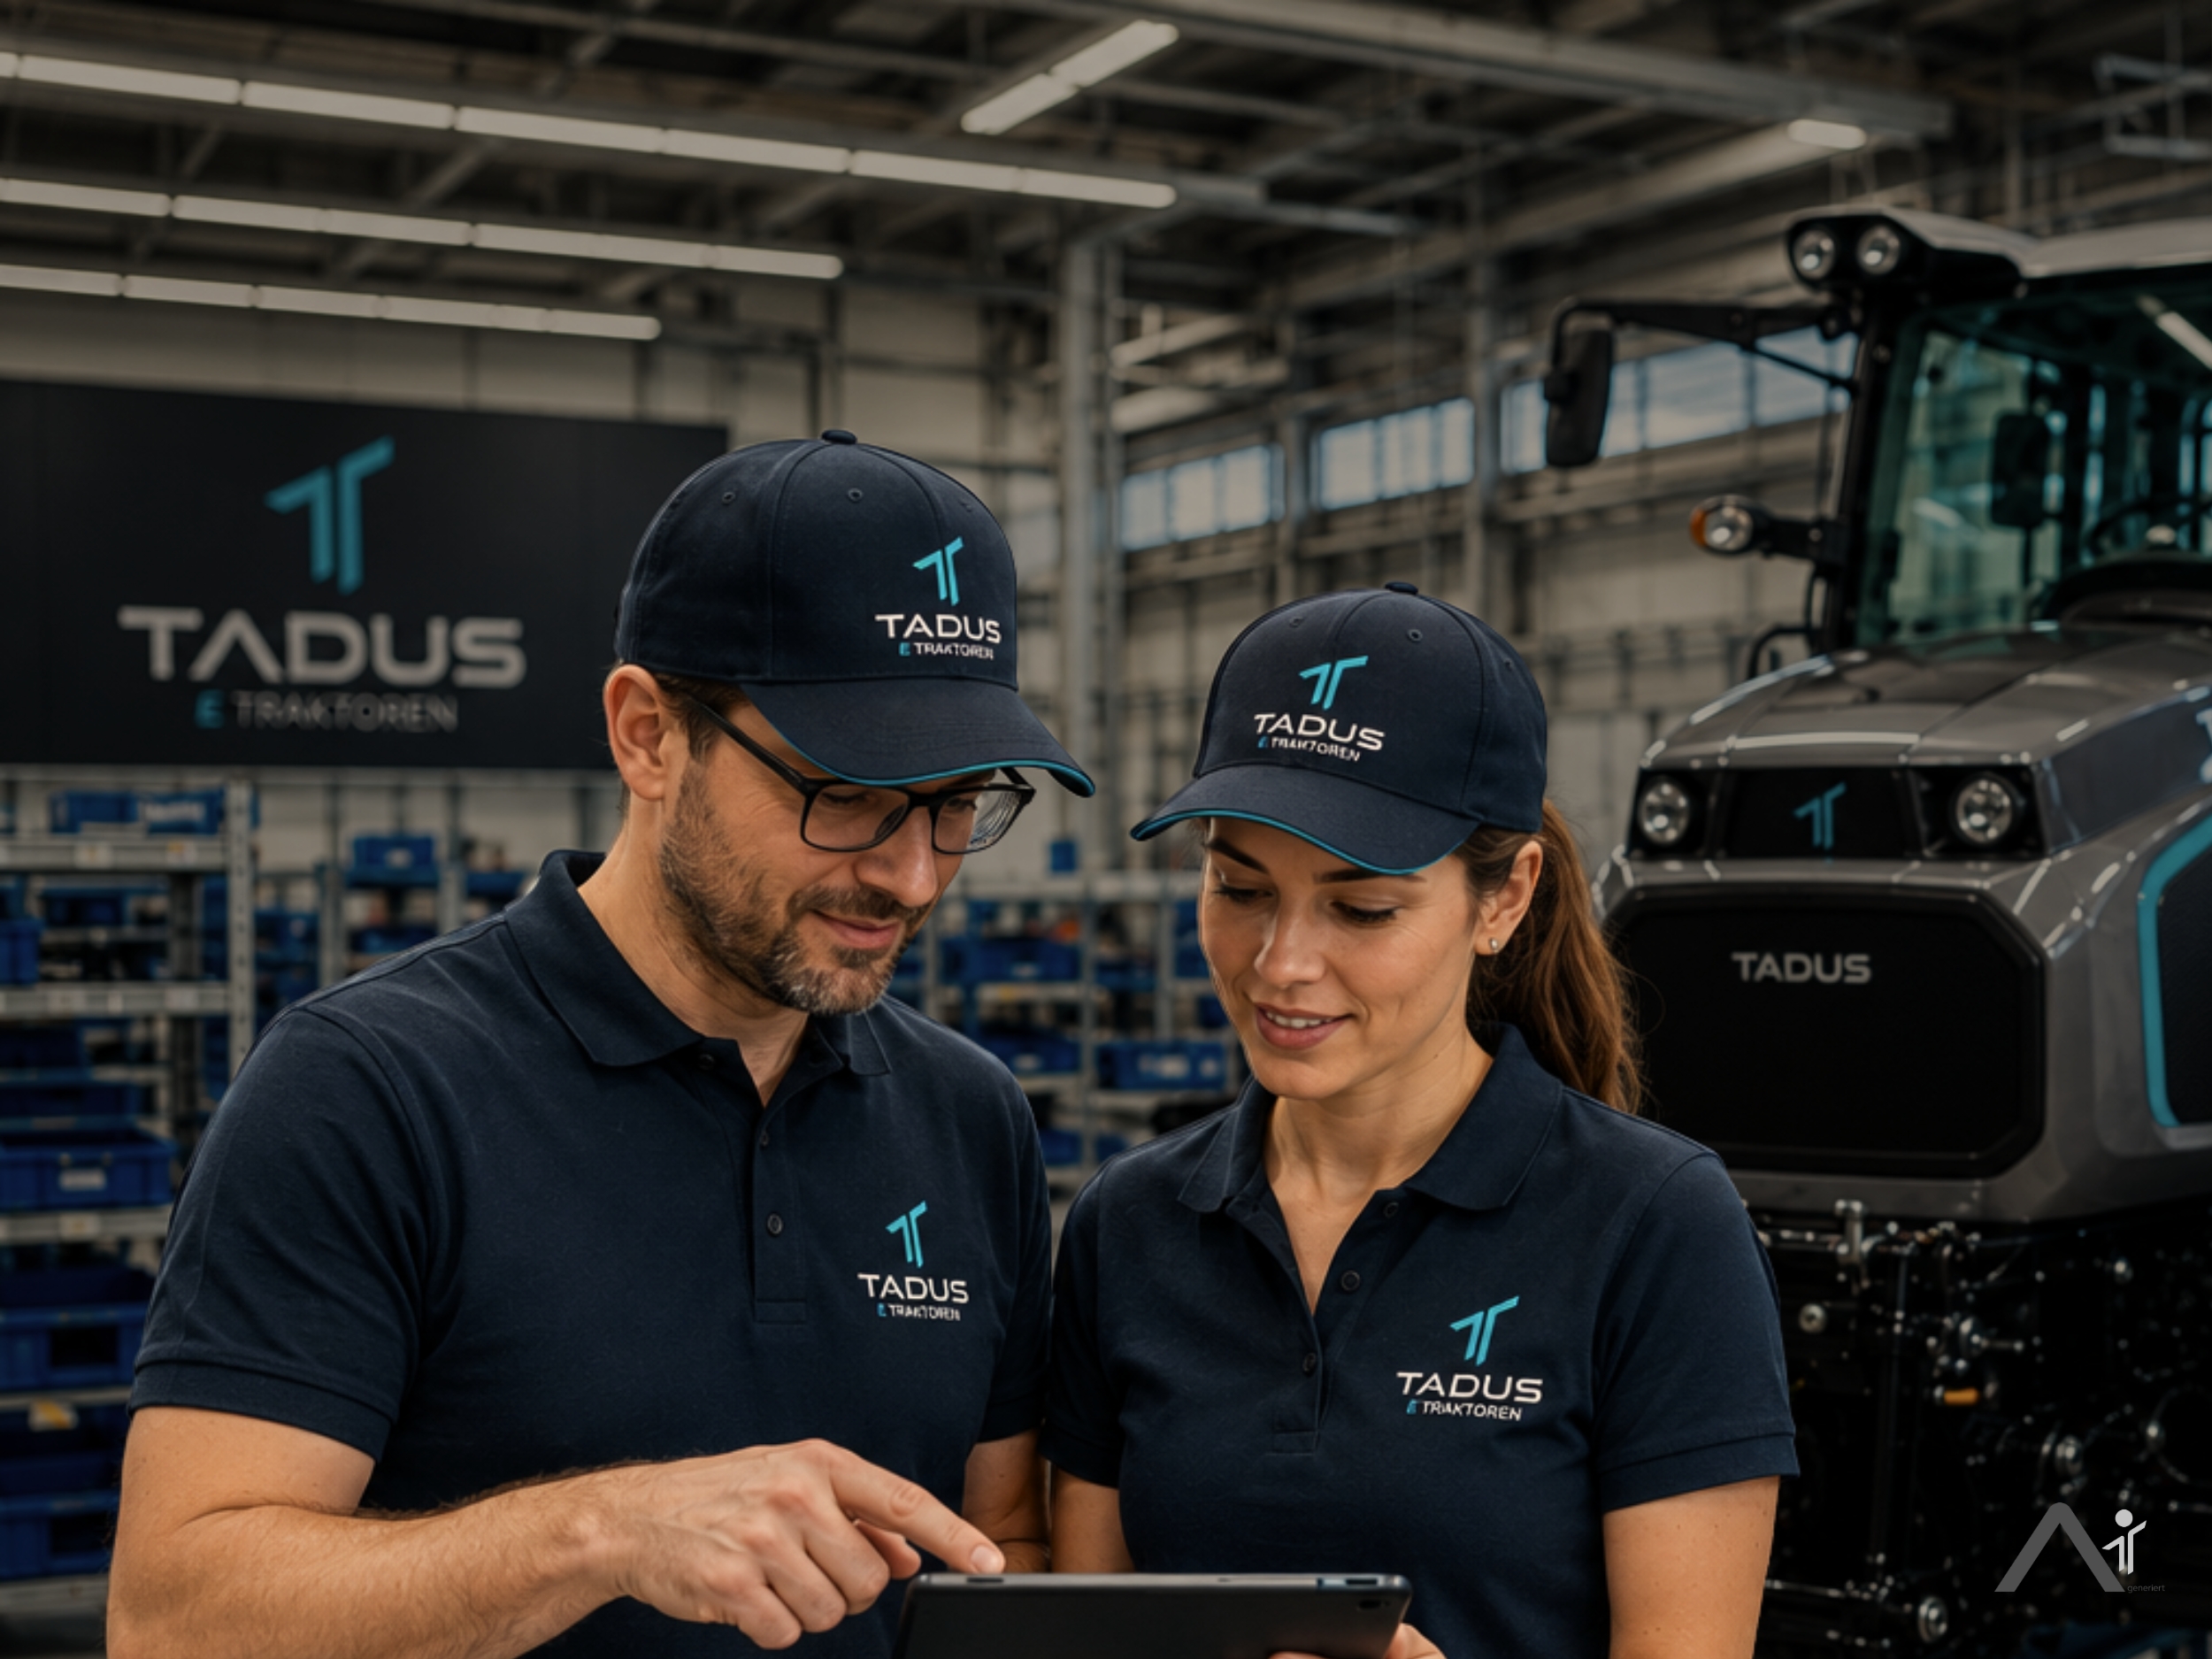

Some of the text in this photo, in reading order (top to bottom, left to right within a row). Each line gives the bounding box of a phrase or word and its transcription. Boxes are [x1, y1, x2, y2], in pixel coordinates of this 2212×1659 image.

[874, 612, 1002, 644] TADUS
[118, 605, 526, 688] TADUS
[233, 690, 458, 731] TRAKTOREN
[1254, 713, 1385, 750] TADUS
[1731, 951, 1871, 983] TADUS
[857, 1272, 969, 1303] TADUS
[1396, 1372, 1543, 1403] TADUS
[1422, 1401, 1522, 1421] TRAKTOREN
